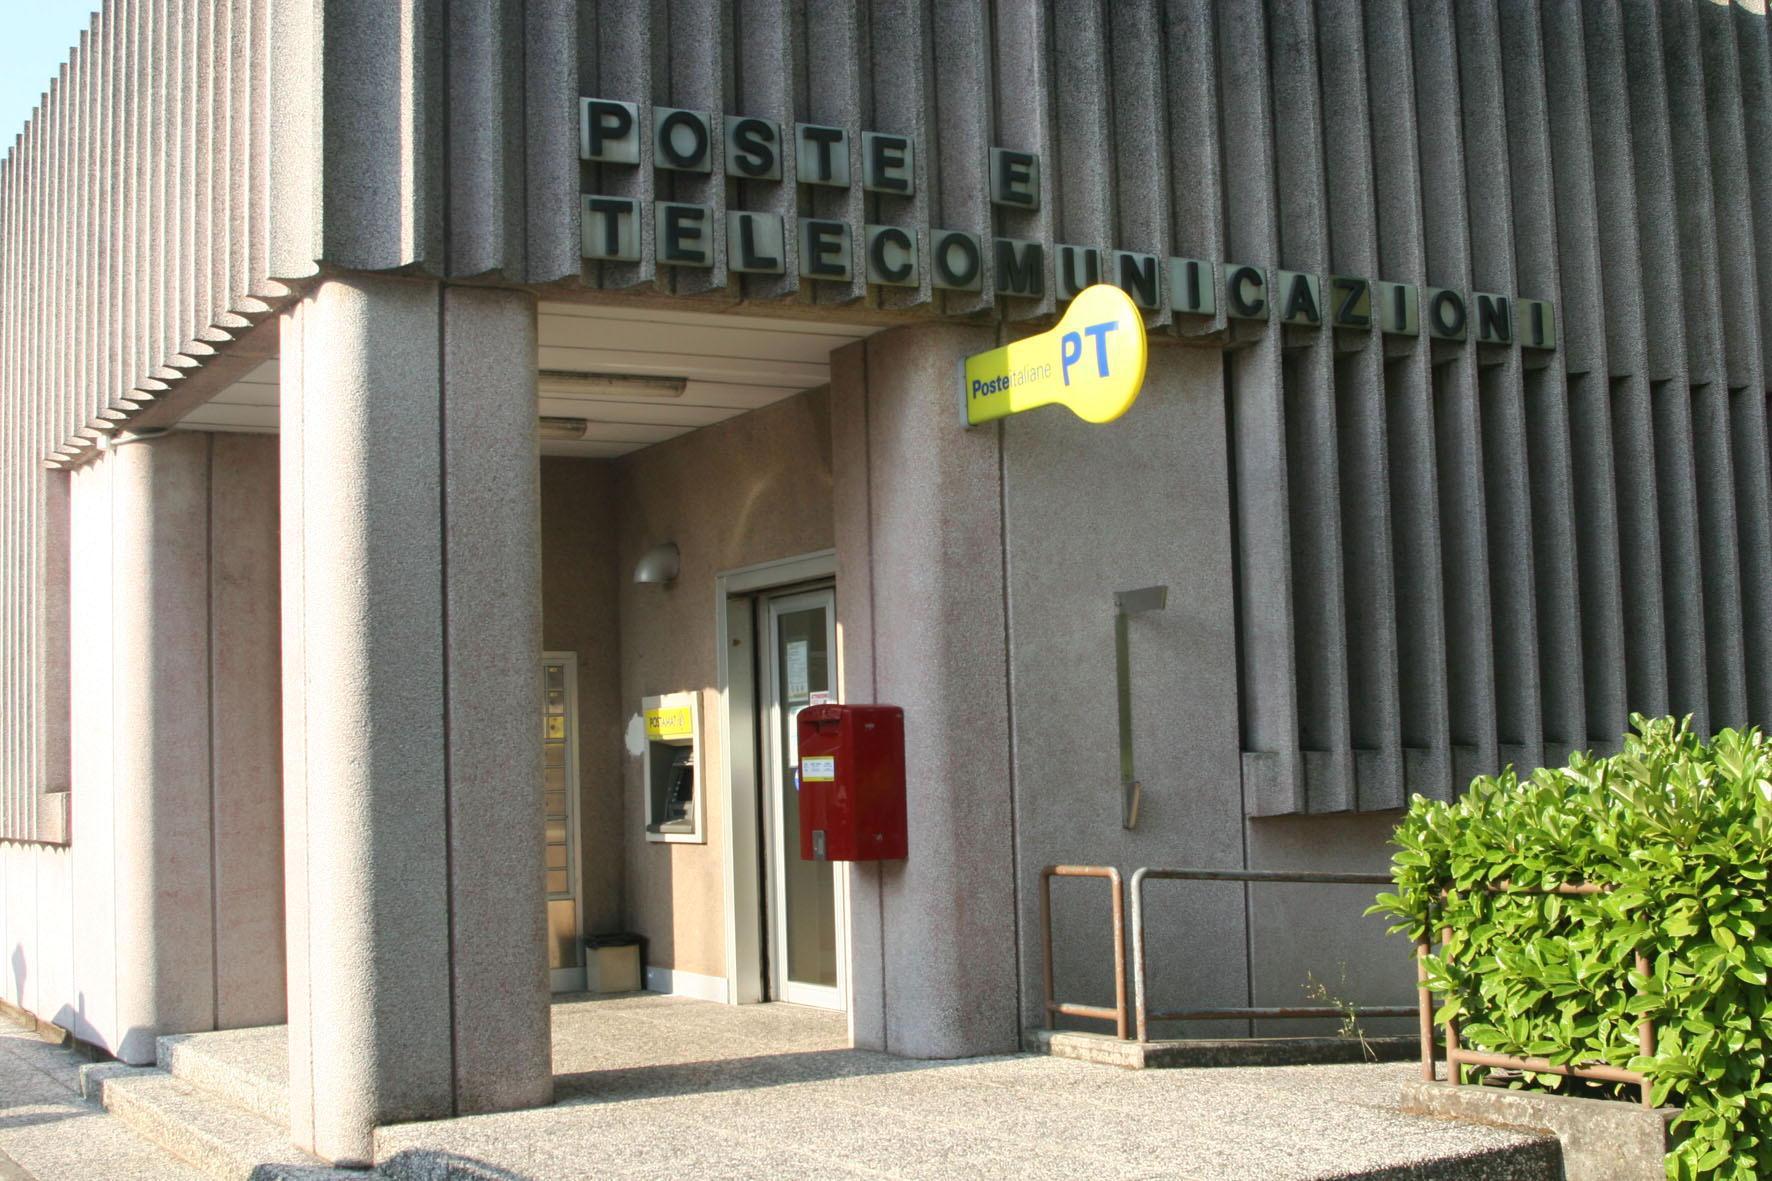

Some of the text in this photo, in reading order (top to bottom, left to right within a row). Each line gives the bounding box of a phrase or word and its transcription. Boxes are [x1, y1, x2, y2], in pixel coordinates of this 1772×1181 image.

[588, 101, 1035, 202] POSTE E
[588, 199, 1545, 348] TELECOMUNICAZIONI
[1061, 320, 1119, 387] PT
